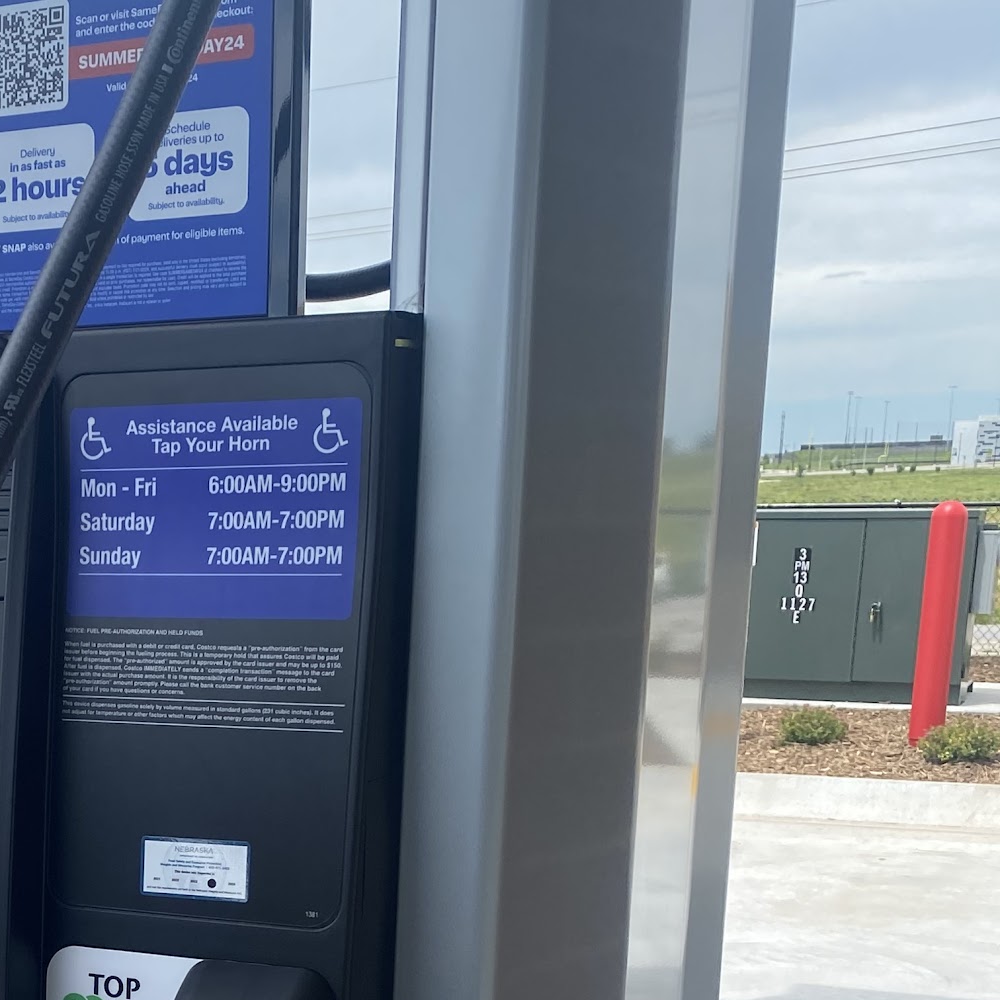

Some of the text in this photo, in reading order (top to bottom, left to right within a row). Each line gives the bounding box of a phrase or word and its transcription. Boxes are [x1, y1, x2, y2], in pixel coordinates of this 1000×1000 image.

[75, 9, 129, 25] Scan or visit
[75, 18, 155, 37] and enter the cod
[106, 82, 127, 92] Valid
[199, 134, 212, 144] up
[214, 133, 224, 142] to
[20, 147, 55, 158] Delivery
[21, 163, 32, 171] as
[34, 159, 52, 170] fast
[55, 160, 66, 168] as
[164, 149, 234, 177] days
[12, 176, 84, 202] hours
[165, 180, 206, 195] ahead
[148, 201, 175, 210] Subject
[120, 226, 245, 244] of payment for eligible items.
[2, 243, 26, 253] SNAP
[27, 242, 44, 251] also
[40, 230, 101, 340] FUTURA
[16, 342, 47, 388] FLEXSTEEL
[126, 414, 298, 436] Assistance Available
[151, 435, 270, 457] Tap Your Horn
[81, 478, 117, 498] Mon
[135, 477, 157, 497] Fri
[208, 472, 346, 495] 6:00AM-9:00PM
[80, 509, 345, 535] Saturday 7:00AM-7:00PM
[79, 545, 343, 569] Sunday 7:00AM-7:00PM
[799, 548, 807, 561] 3
[795, 560, 810, 571] PM
[793, 571, 808, 584] 13
[781, 597, 816, 611] 1127
[174, 845, 214, 855] NEBRASKA
[88, 973, 141, 1000] TOP
